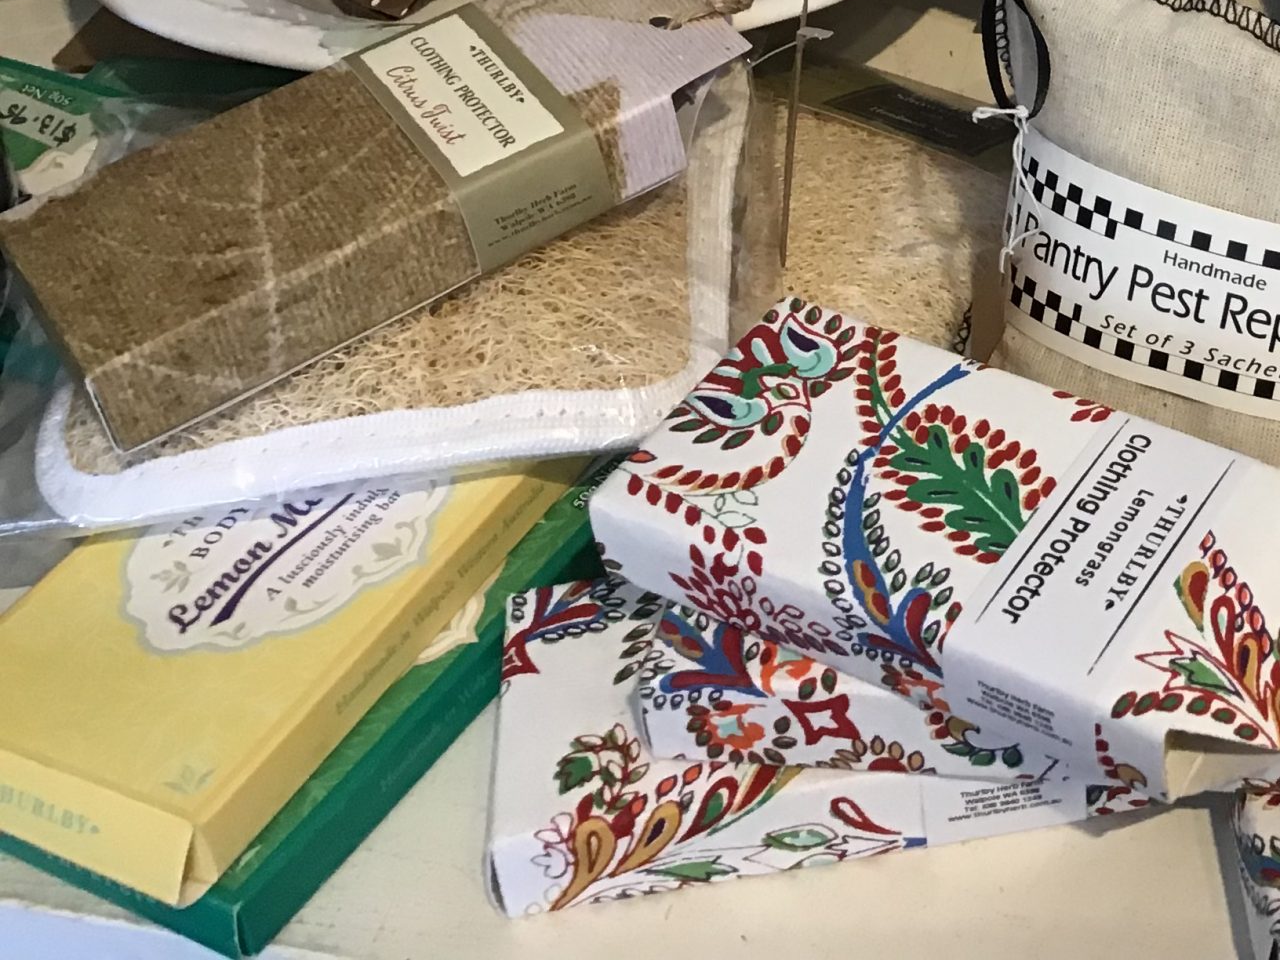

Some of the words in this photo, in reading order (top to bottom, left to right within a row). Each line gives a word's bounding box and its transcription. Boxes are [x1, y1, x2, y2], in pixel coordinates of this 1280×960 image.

[386, 64, 425, 110] Citrus
[421, 102, 467, 147] Twist
[410, 35, 456, 88] CLOTHING
[451, 82, 516, 150] PROTECTOR
[472, 47, 523, 101] THURLBY
[1019, 211, 1120, 303] Pantry
[1126, 262, 1212, 326] Pest
[1162, 248, 1268, 293] Handmade
[1099, 311, 1139, 342] Set
[1144, 328, 1172, 350] of
[1179, 339, 1194, 357] 3
[1076, 433, 1153, 516] Clothing
[189, 506, 251, 560] BODY
[265, 586, 281, 602] A
[279, 524, 348, 585] lusciously
[302, 512, 384, 589] moisturising
[377, 488, 402, 512] bar
[1001, 516, 1093, 625] Protector
[1075, 488, 1155, 588] Lemongrass
[1108, 503, 1187, 603] THURLBY
[167, 538, 274, 635] Lemon
